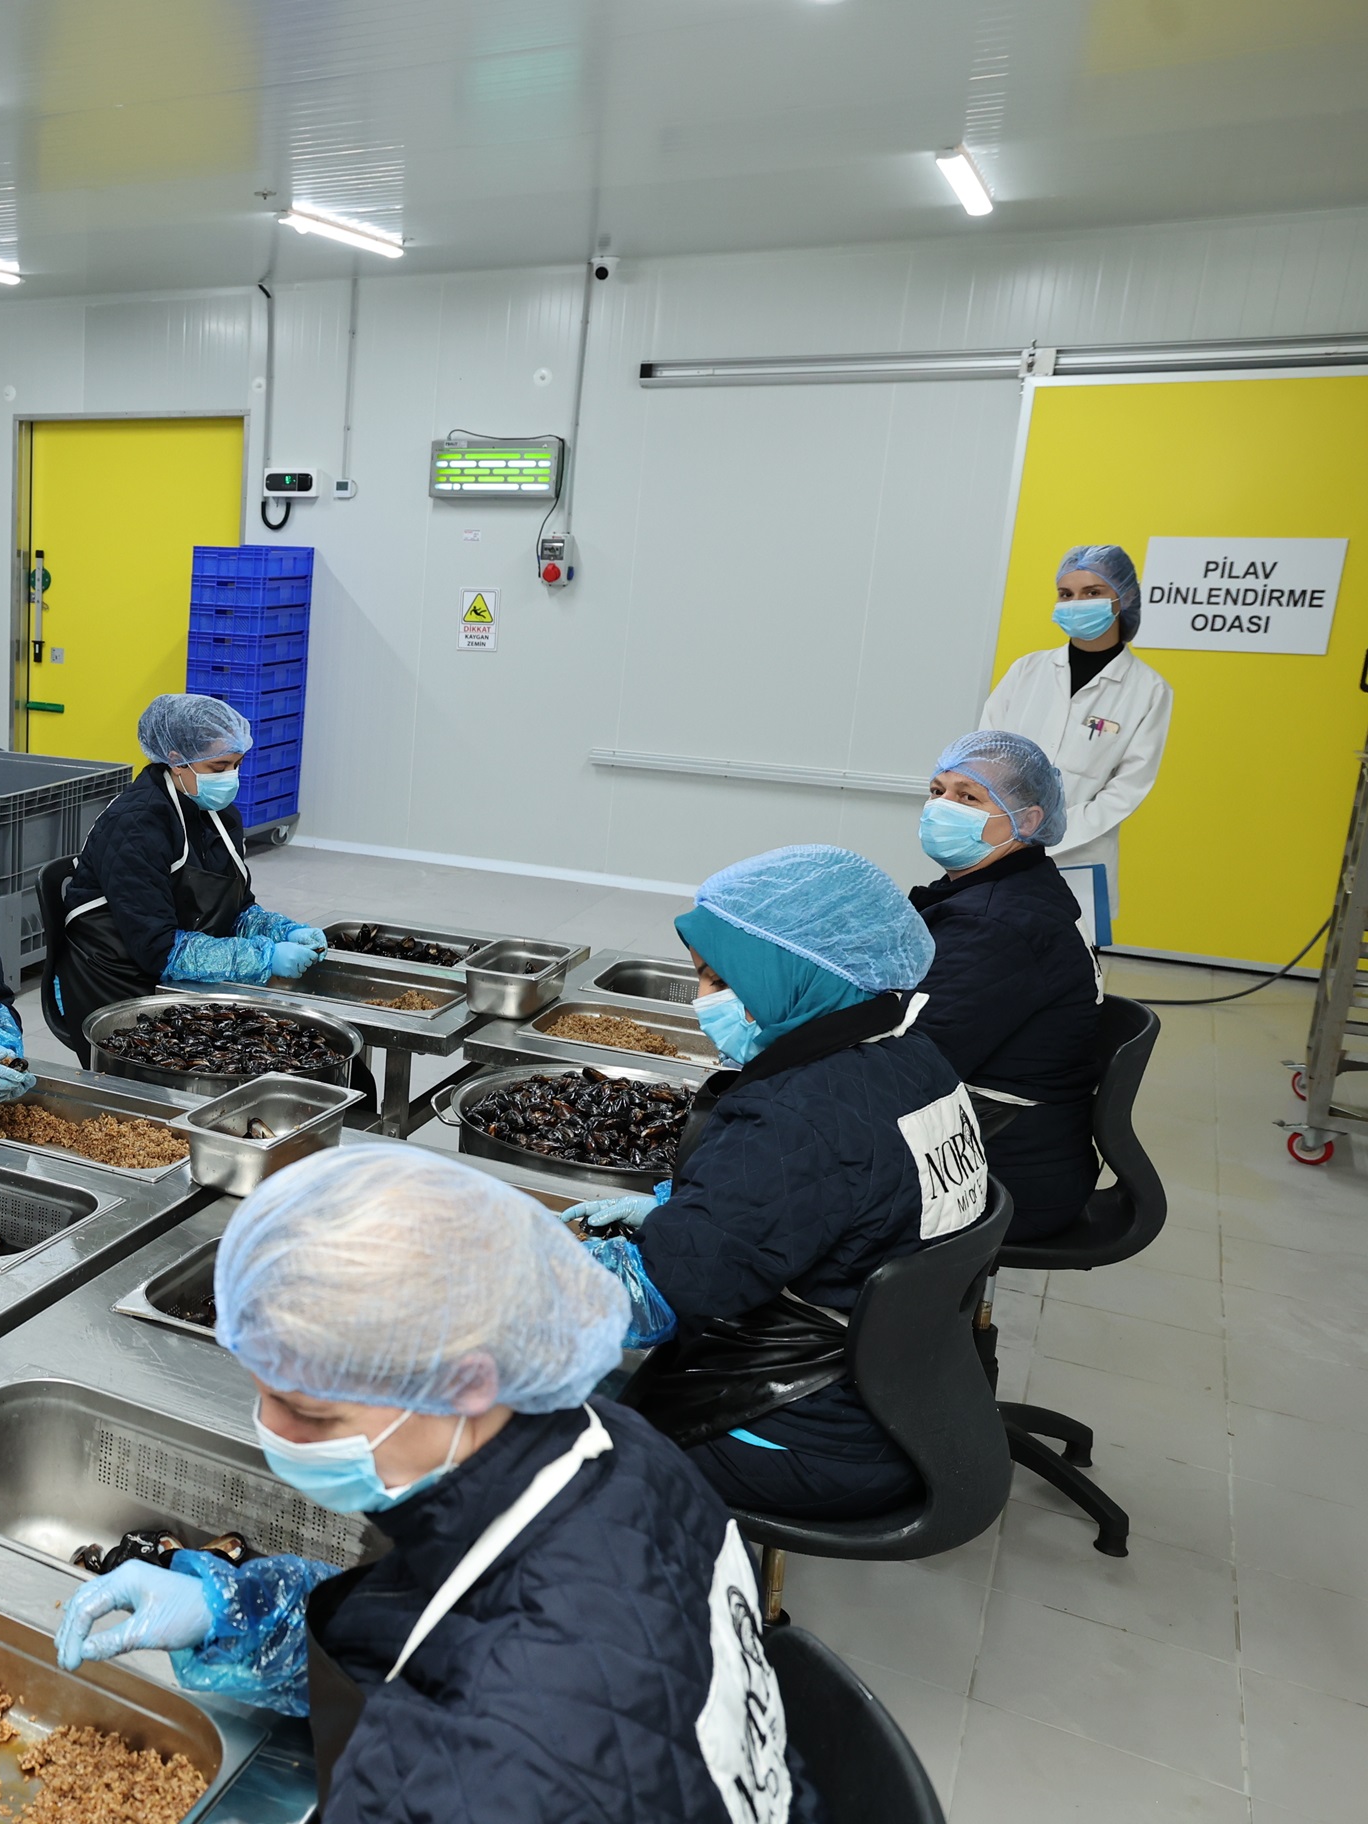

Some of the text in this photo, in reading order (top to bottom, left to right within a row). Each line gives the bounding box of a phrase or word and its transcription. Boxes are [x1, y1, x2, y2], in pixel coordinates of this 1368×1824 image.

[1203, 556, 1278, 580] PİLAV
[1149, 582, 1326, 608] DİNLENDİRME
[463, 624, 491, 633] DİKKAT
[1191, 613, 1270, 634] ODASI
